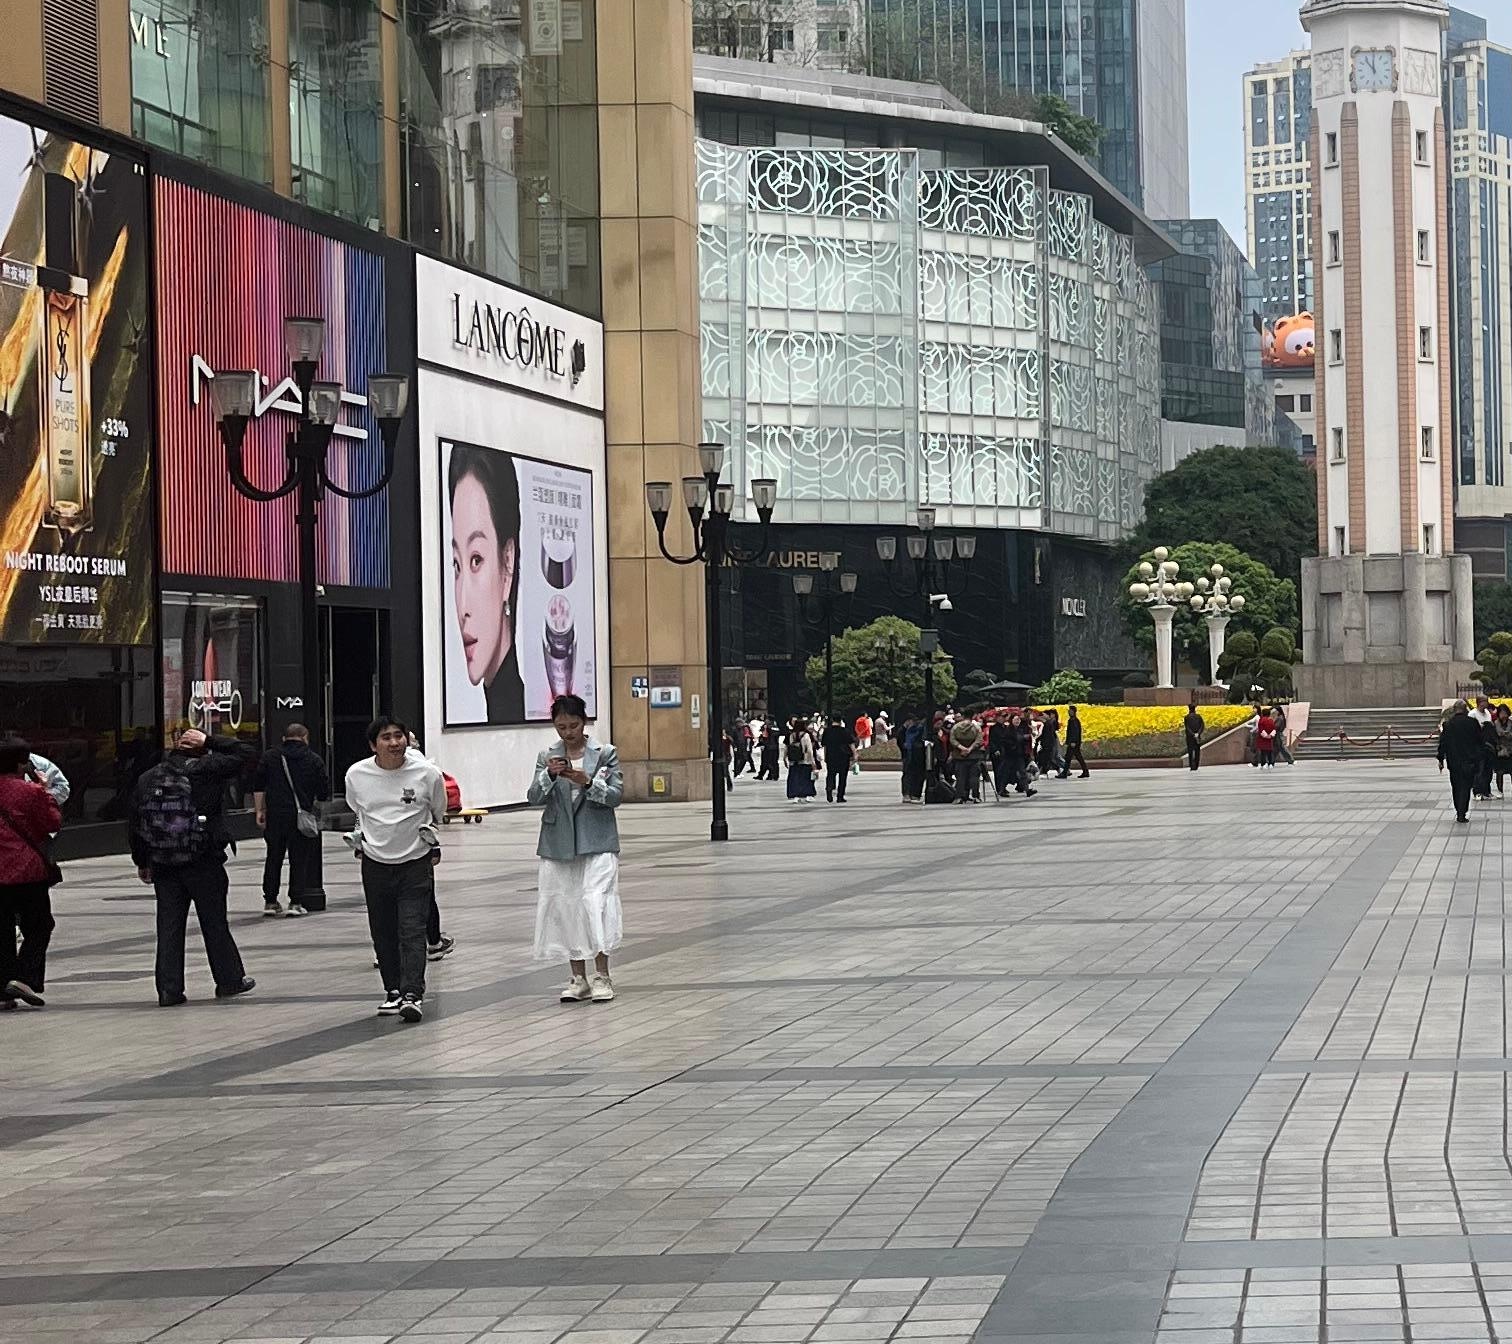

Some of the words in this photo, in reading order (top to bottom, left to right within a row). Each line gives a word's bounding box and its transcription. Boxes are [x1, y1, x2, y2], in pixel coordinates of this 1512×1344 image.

[453, 292, 566, 377] LANCÔME
[52, 416, 79, 433] SHOTS
[101, 418, 129, 437] +33%
[5, 552, 43, 570] NIGHT
[45, 554, 89, 574] REBOOT
[91, 558, 127, 576] SERUM
